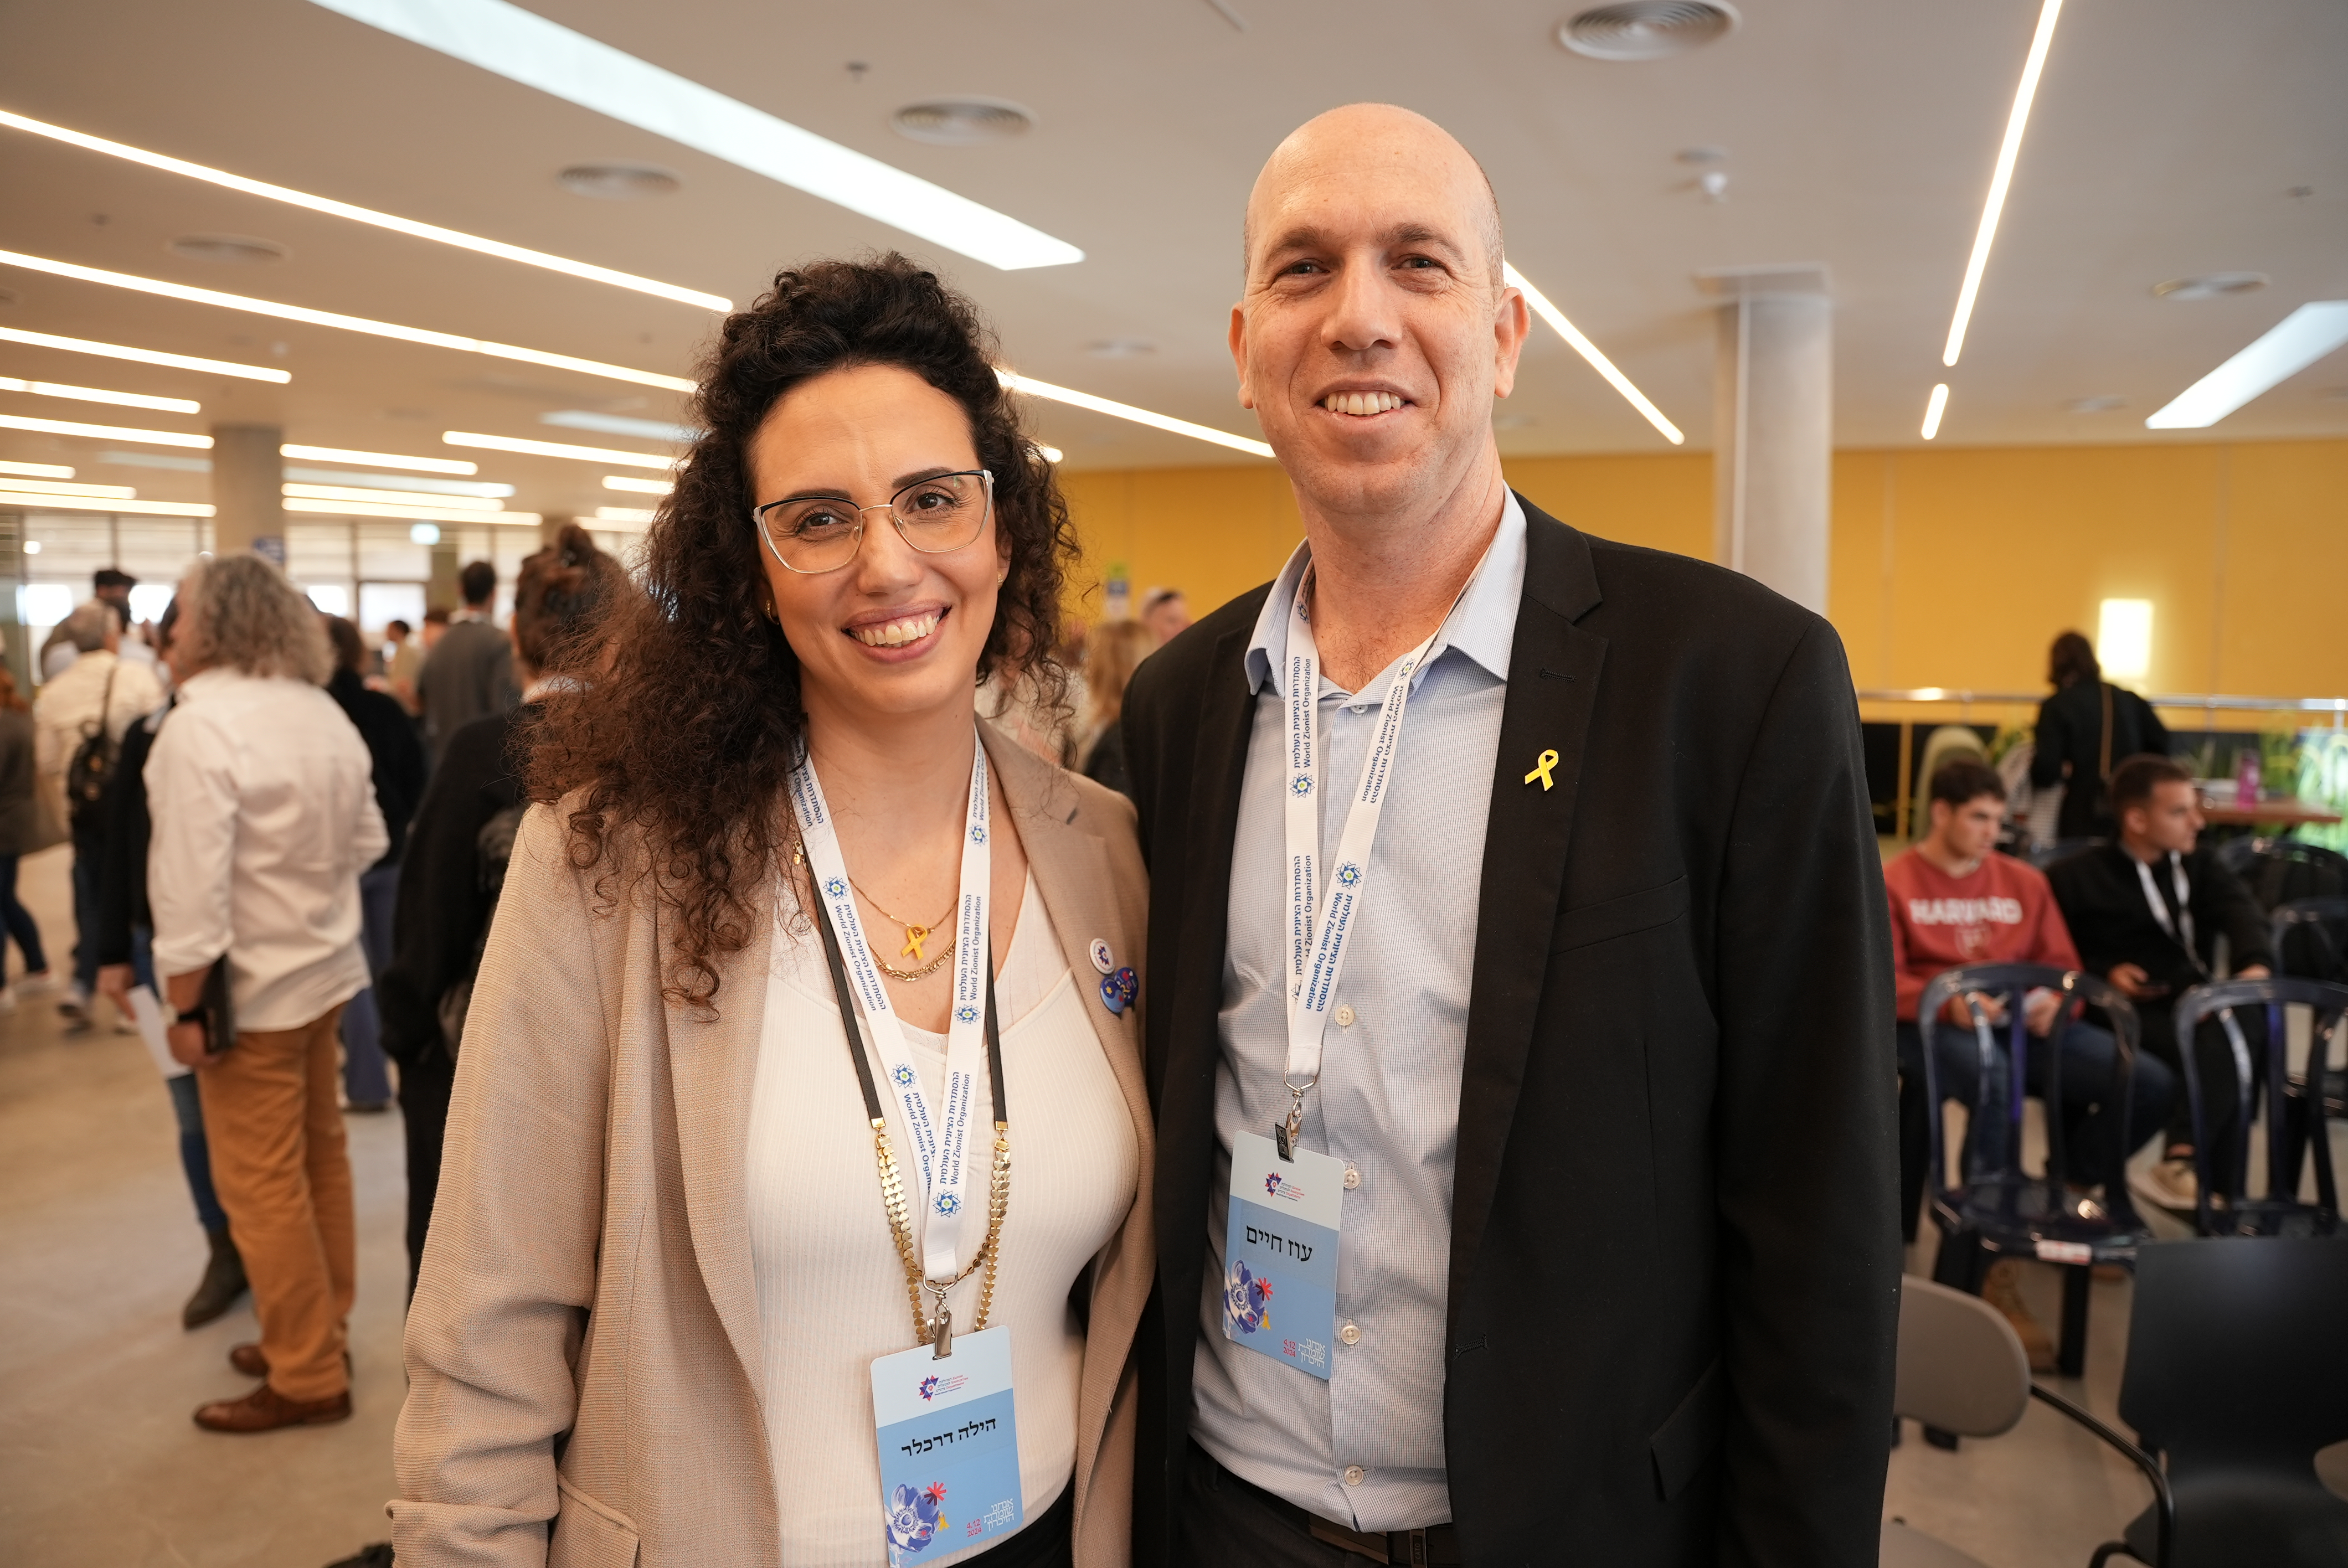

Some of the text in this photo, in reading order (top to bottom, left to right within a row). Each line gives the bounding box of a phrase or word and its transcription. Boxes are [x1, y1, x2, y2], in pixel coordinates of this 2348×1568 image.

[1302, 659, 1311, 707] Organization
[1292, 733, 1300, 768] העולמית
[1362, 686, 1399, 801] World Zionist Organization
[1370, 686, 1403, 803] ההסתדרות הציונית העולמית
[794, 778, 813, 827] Organization
[806, 782, 824, 824] ההסתדרות
[1304, 855, 1314, 912] Organization
[972, 896, 981, 945] Organization
[1330, 893, 1343, 919] World
[1909, 895, 2023, 925] HARVARD
[844, 904, 885, 1009] ההסתדרות הציונית העולמית
[1316, 894, 1352, 1012] ההסתדרות הציונית העולמית
[1321, 920, 1335, 951] Zionist
[835, 905, 876, 1010] World Zionist Organization
[1294, 939, 1302, 976] העולמית
[959, 968, 967, 1000] העולמית
[1306, 953, 1326, 1009] Organization
[904, 1094, 918, 1120] World
[913, 1122, 926, 1152] Zionist
[913, 1092, 929, 1127] העולמית
[940, 1072, 959, 1184] ההסתדרות הציונית העולמית
[950, 1074, 970, 1184] World Zionist Organization
[1246, 1225, 1312, 1262] עוז חיים
[1283, 1347, 1295, 1357] 2024
[902, 1417, 996, 1457] הילה דרכלר
[966, 1519, 981, 1529] 4.12
[991, 1498, 1013, 1512] אנחנו
[967, 1527, 982, 1537] 2024
